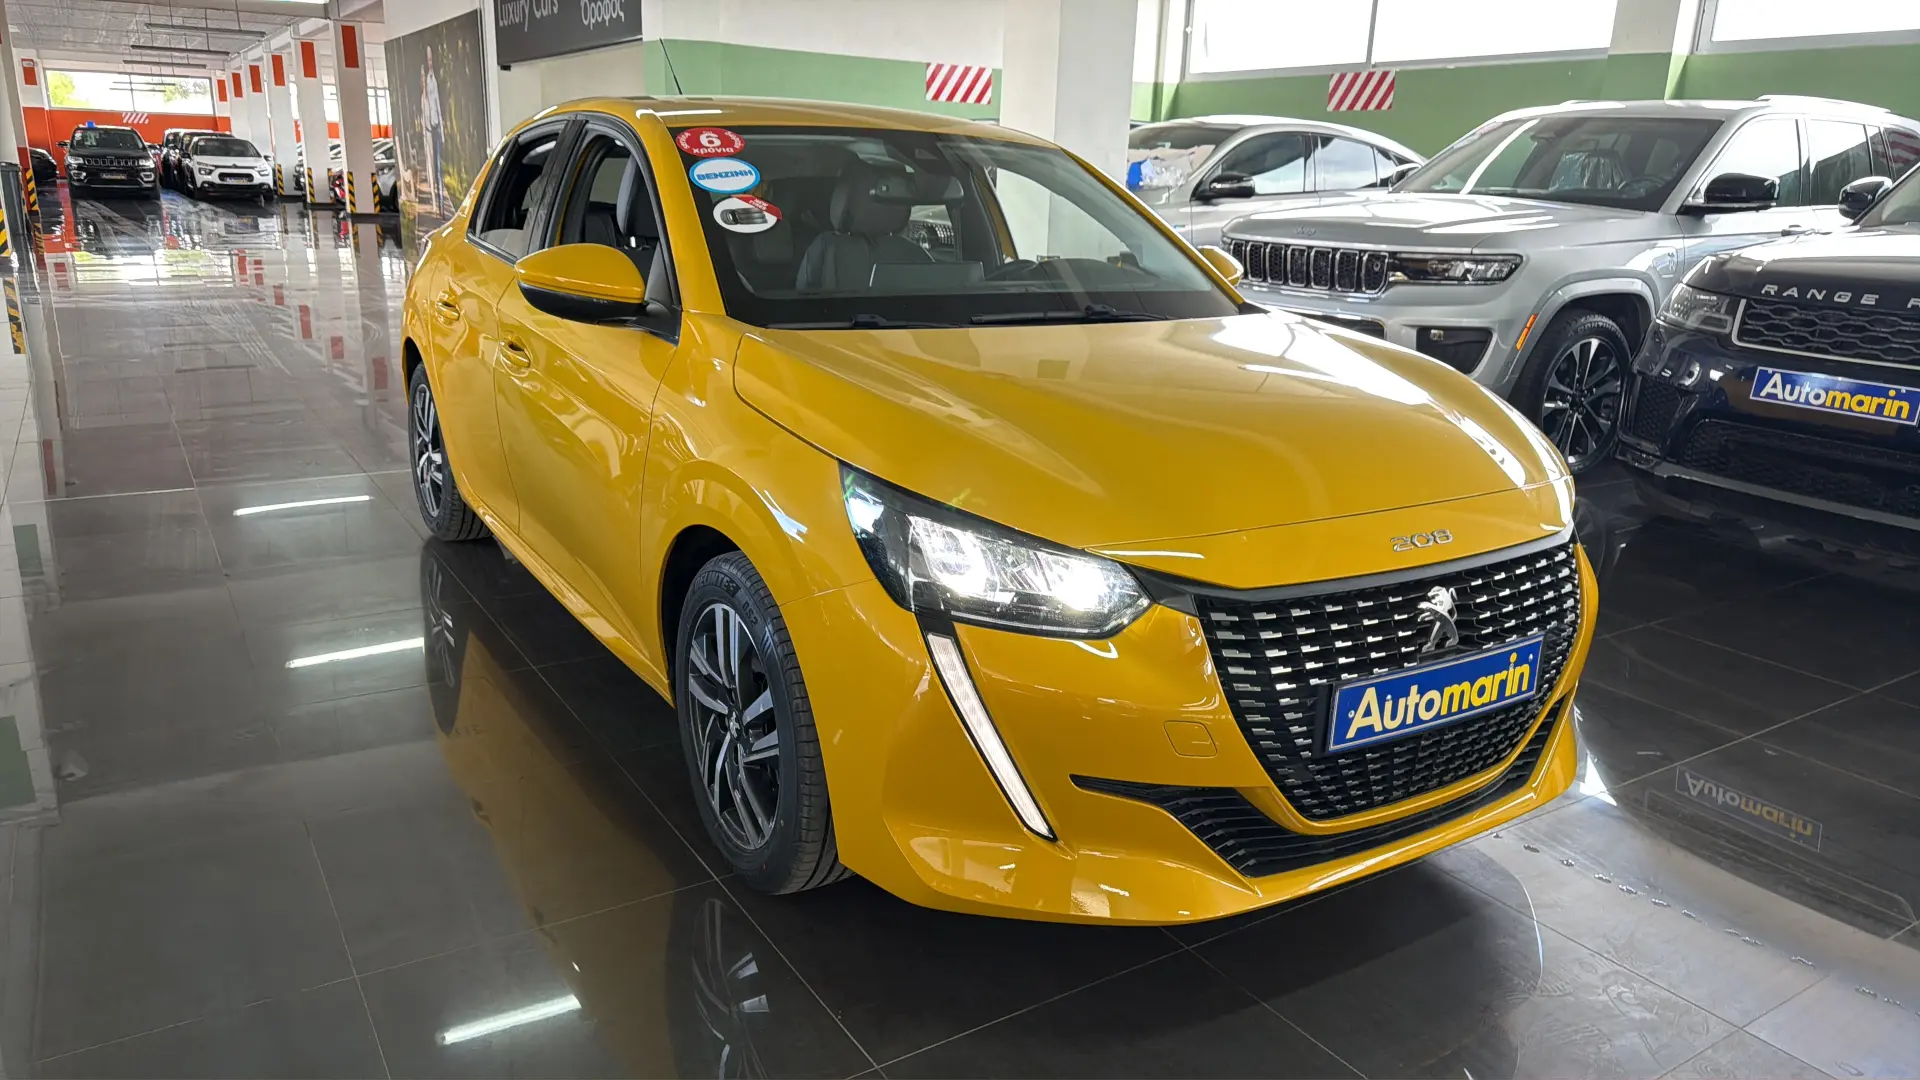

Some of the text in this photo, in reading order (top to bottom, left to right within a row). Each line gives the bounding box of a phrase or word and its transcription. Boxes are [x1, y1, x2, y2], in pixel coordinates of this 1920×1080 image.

[498, 0, 559, 32] Luxury Cars
[692, 147, 735, 156] χρόνια
[699, 133, 722, 148] 6
[1761, 284, 1880, 306] RANGE
[1760, 372, 1910, 420] Automarin
[1390, 529, 1453, 552] 208
[1345, 651, 1531, 740] Automarin
